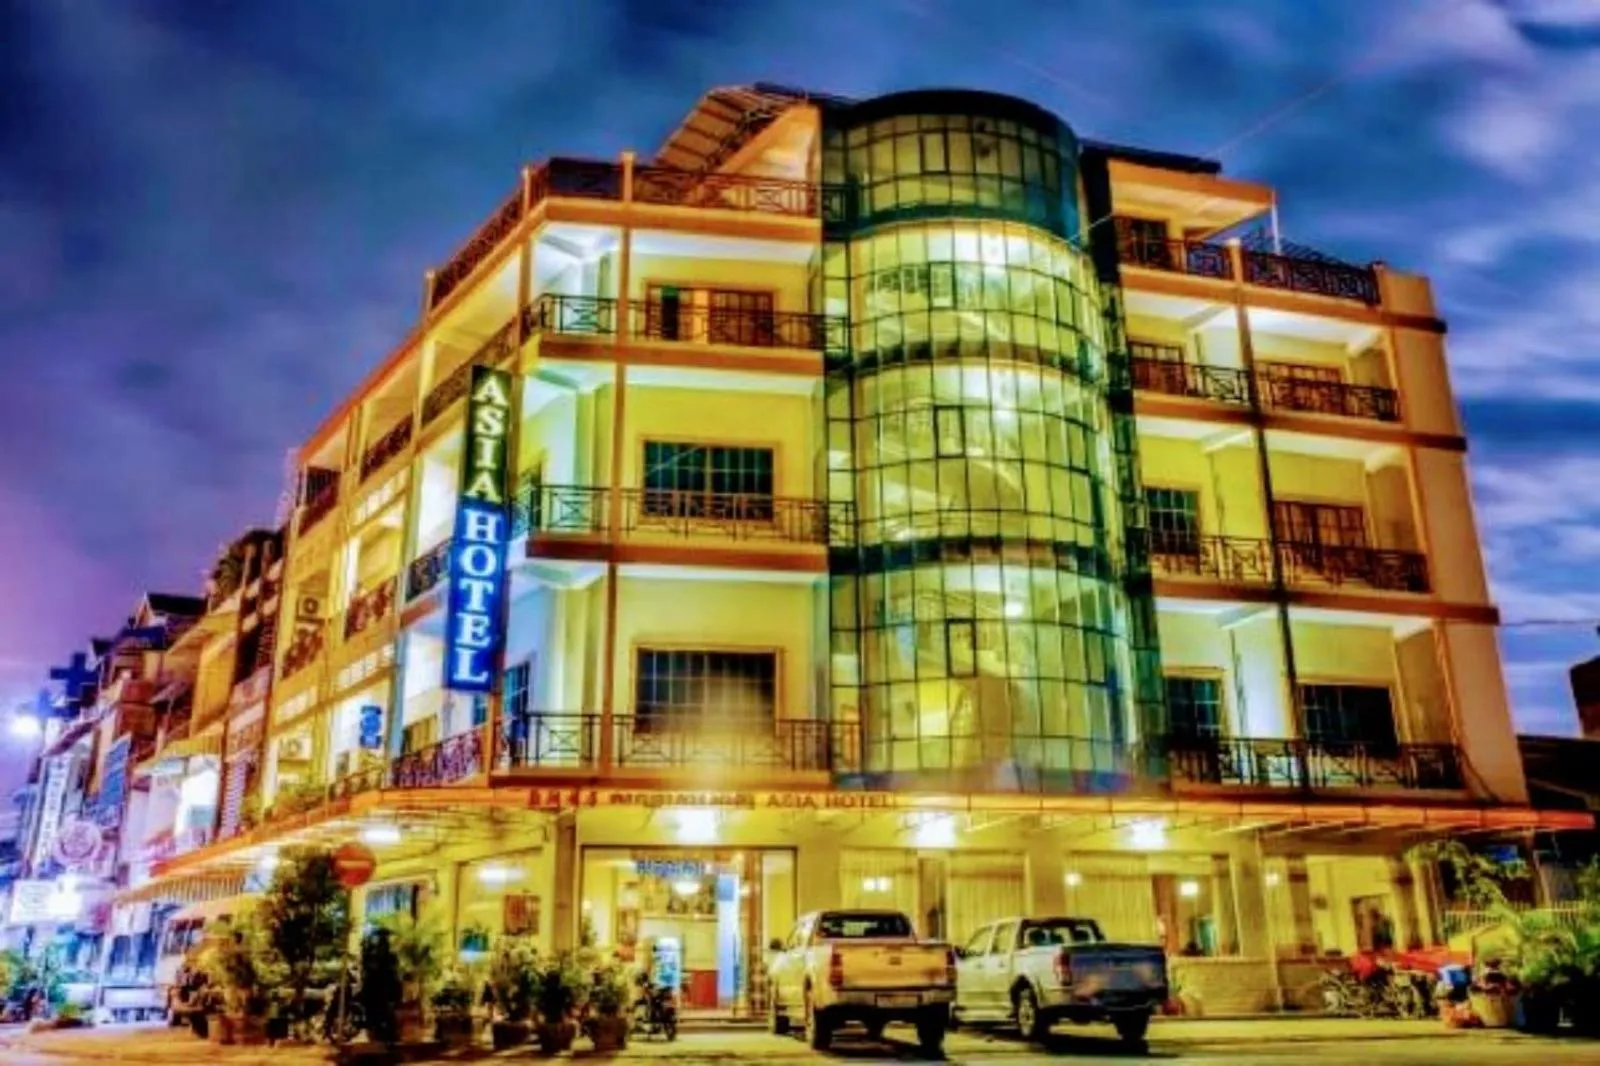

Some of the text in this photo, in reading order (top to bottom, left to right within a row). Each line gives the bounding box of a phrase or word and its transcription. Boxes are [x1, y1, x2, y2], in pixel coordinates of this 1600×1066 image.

[454, 378, 508, 682] ASIA HOTEL
[826, 793, 891, 808] HOTEL
